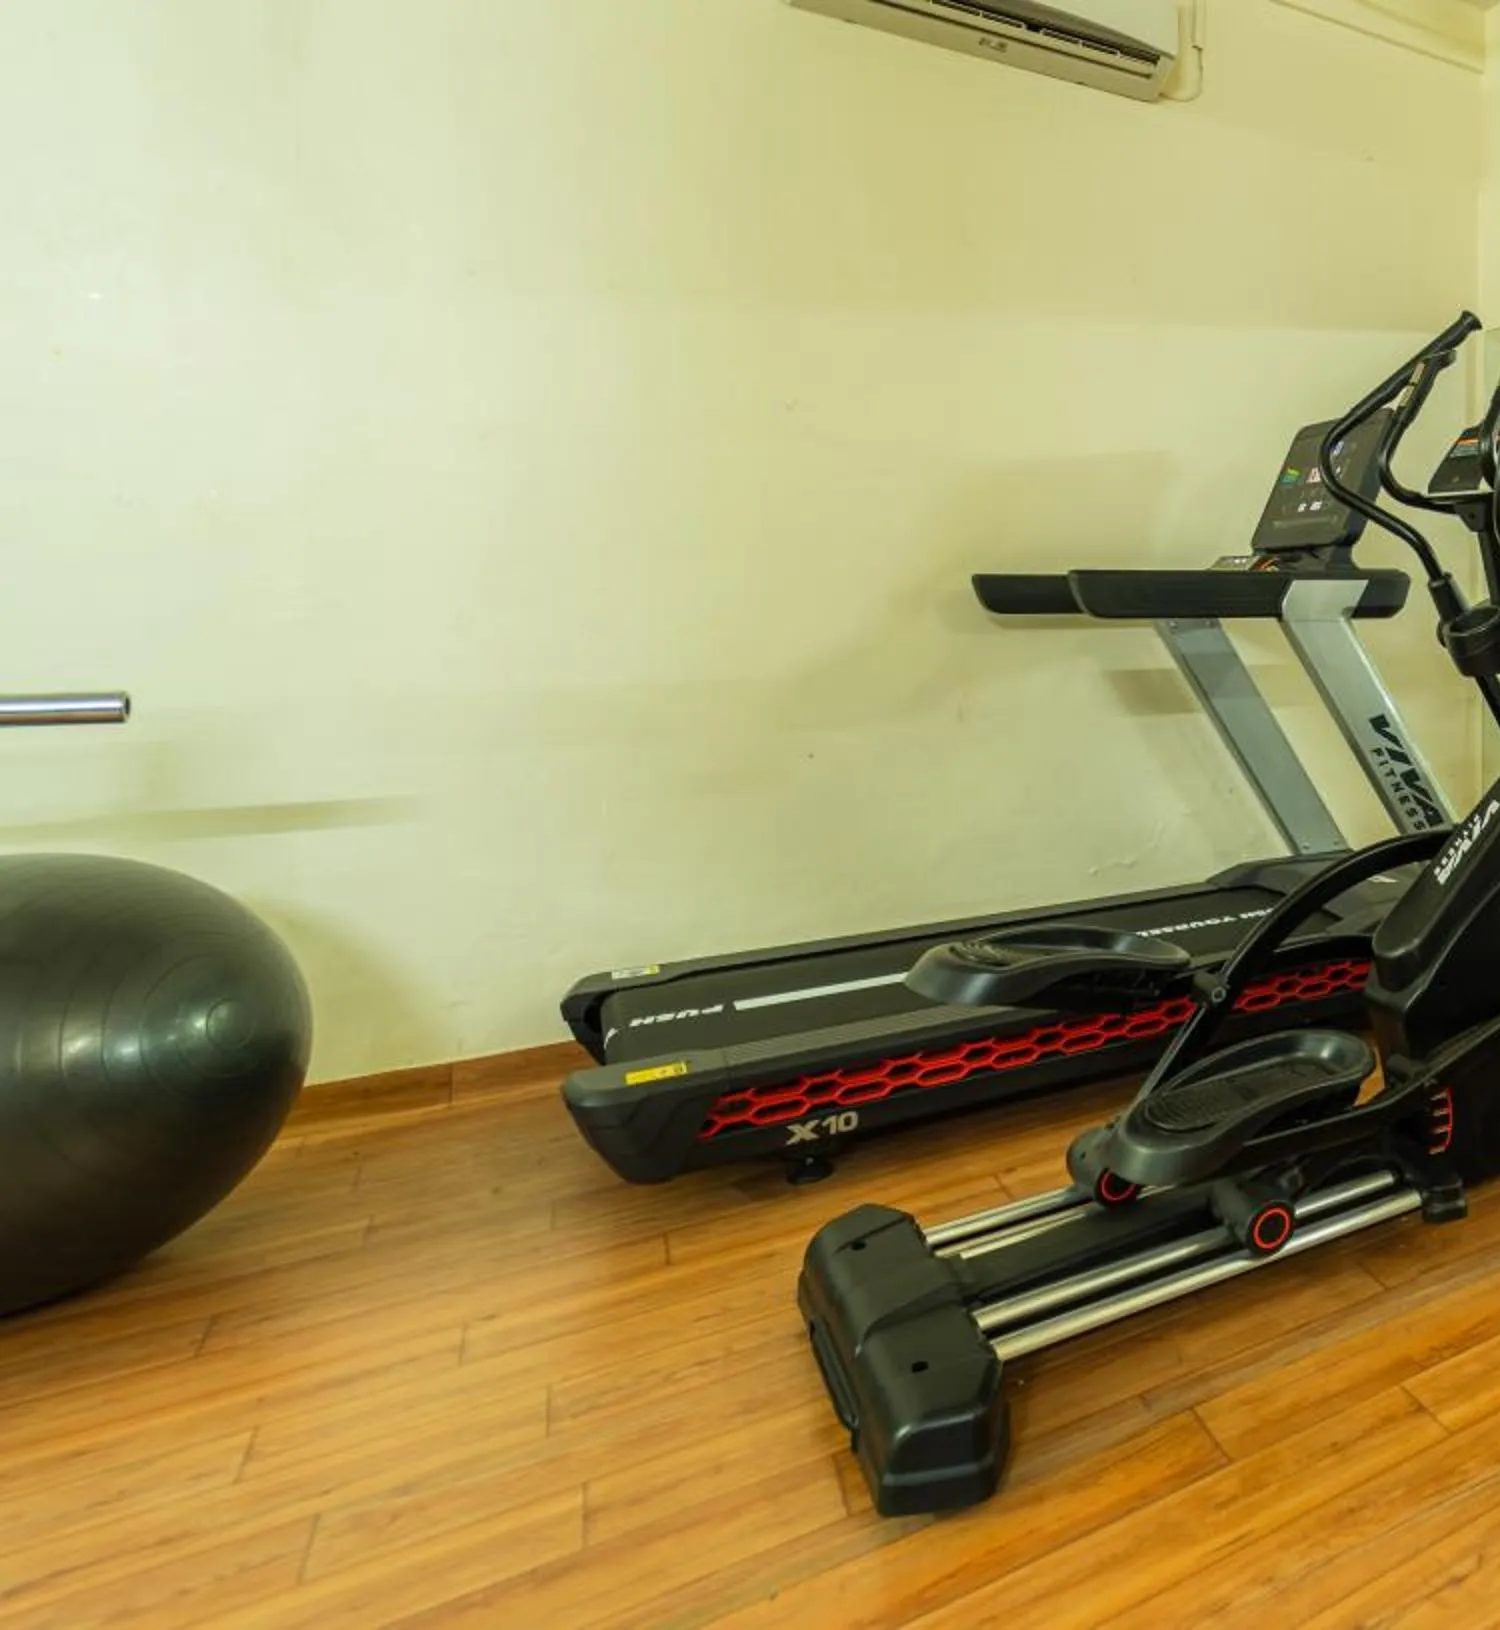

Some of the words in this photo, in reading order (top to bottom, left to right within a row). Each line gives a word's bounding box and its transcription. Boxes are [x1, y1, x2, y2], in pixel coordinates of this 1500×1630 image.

[1369, 714, 1444, 828] VIVA
[1371, 747, 1426, 831] FITNESS
[1136, 915, 1238, 937] YOURSEL
